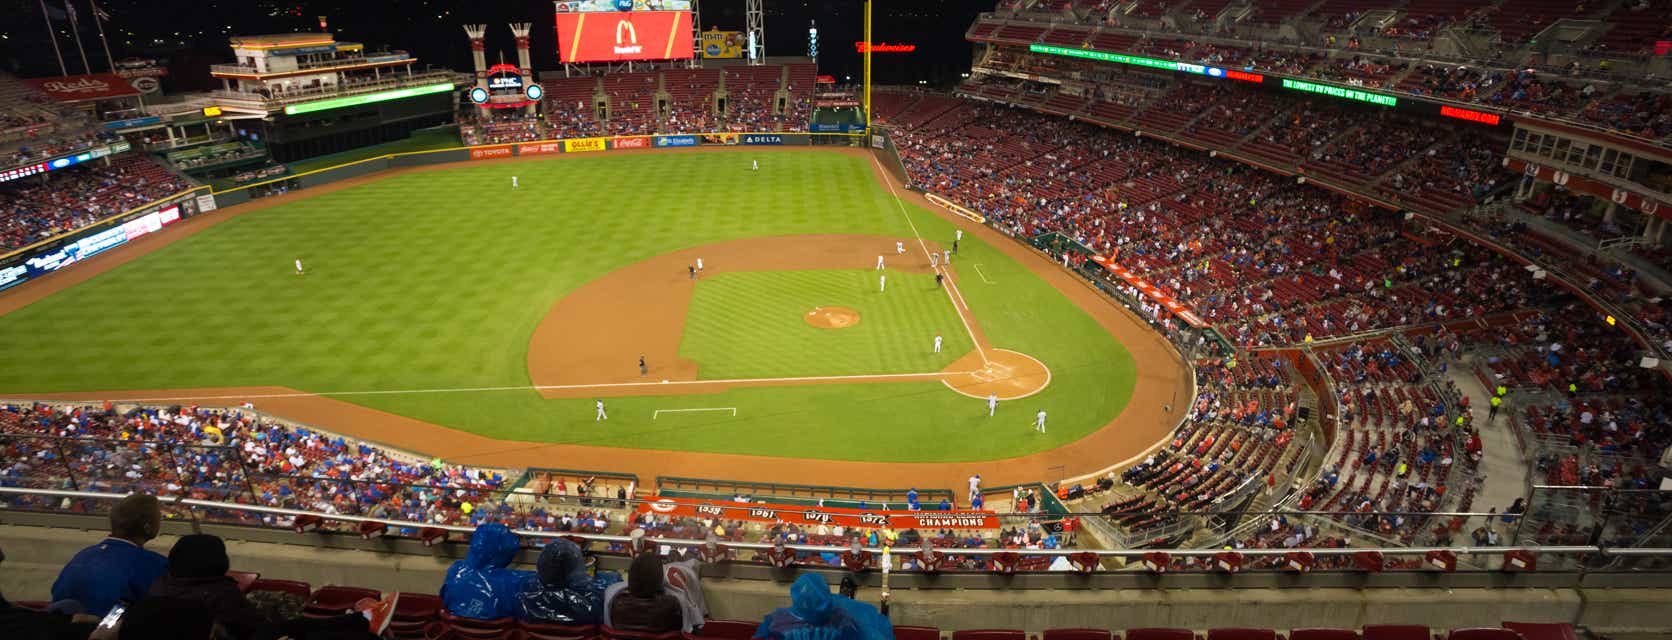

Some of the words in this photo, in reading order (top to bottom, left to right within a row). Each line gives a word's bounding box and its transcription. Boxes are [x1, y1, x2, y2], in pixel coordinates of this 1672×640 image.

[855, 42, 916, 53] Budweiser
[44, 77, 109, 92] Reds
[1293, 81, 1316, 92] LOWEST
[1324, 86, 1345, 97] PRICES
[1345, 90, 1354, 99] ON
[1354, 91, 1366, 101] THE
[919, 518, 984, 526] CHAMPIONS
